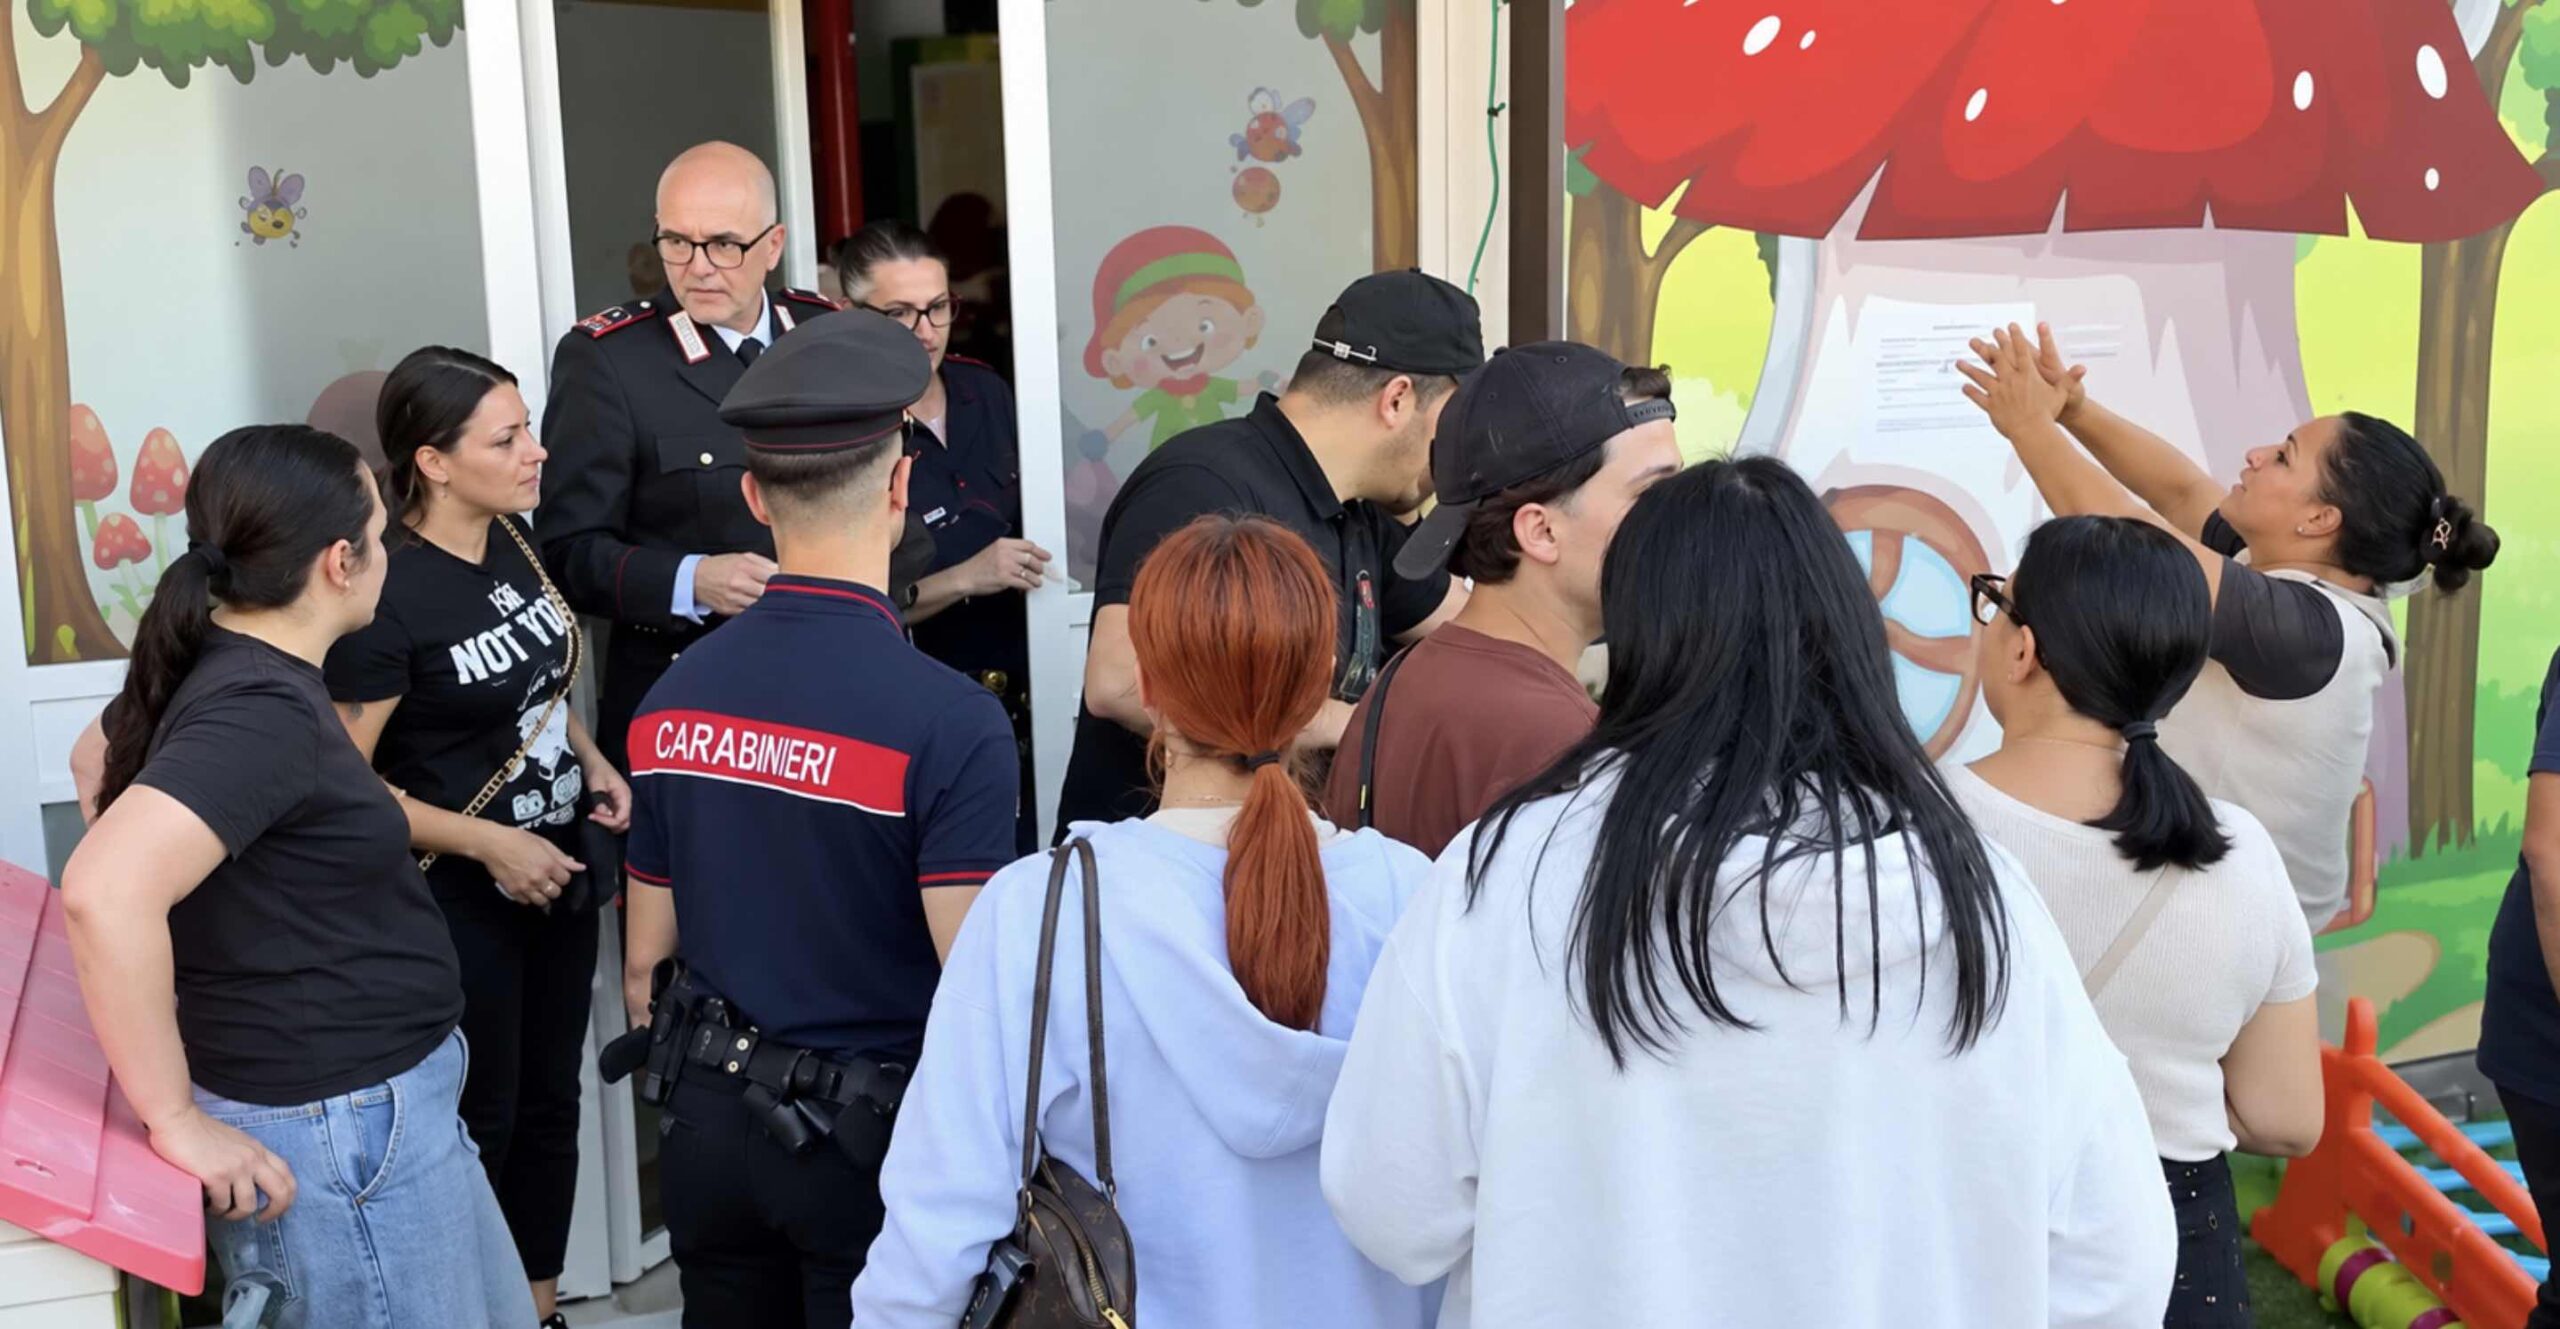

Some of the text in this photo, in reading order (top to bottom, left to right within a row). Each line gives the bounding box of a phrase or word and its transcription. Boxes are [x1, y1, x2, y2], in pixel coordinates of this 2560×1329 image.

[449, 622, 529, 686] NOT
[517, 592, 567, 647] YO
[655, 720, 837, 787] CARABINIERI
